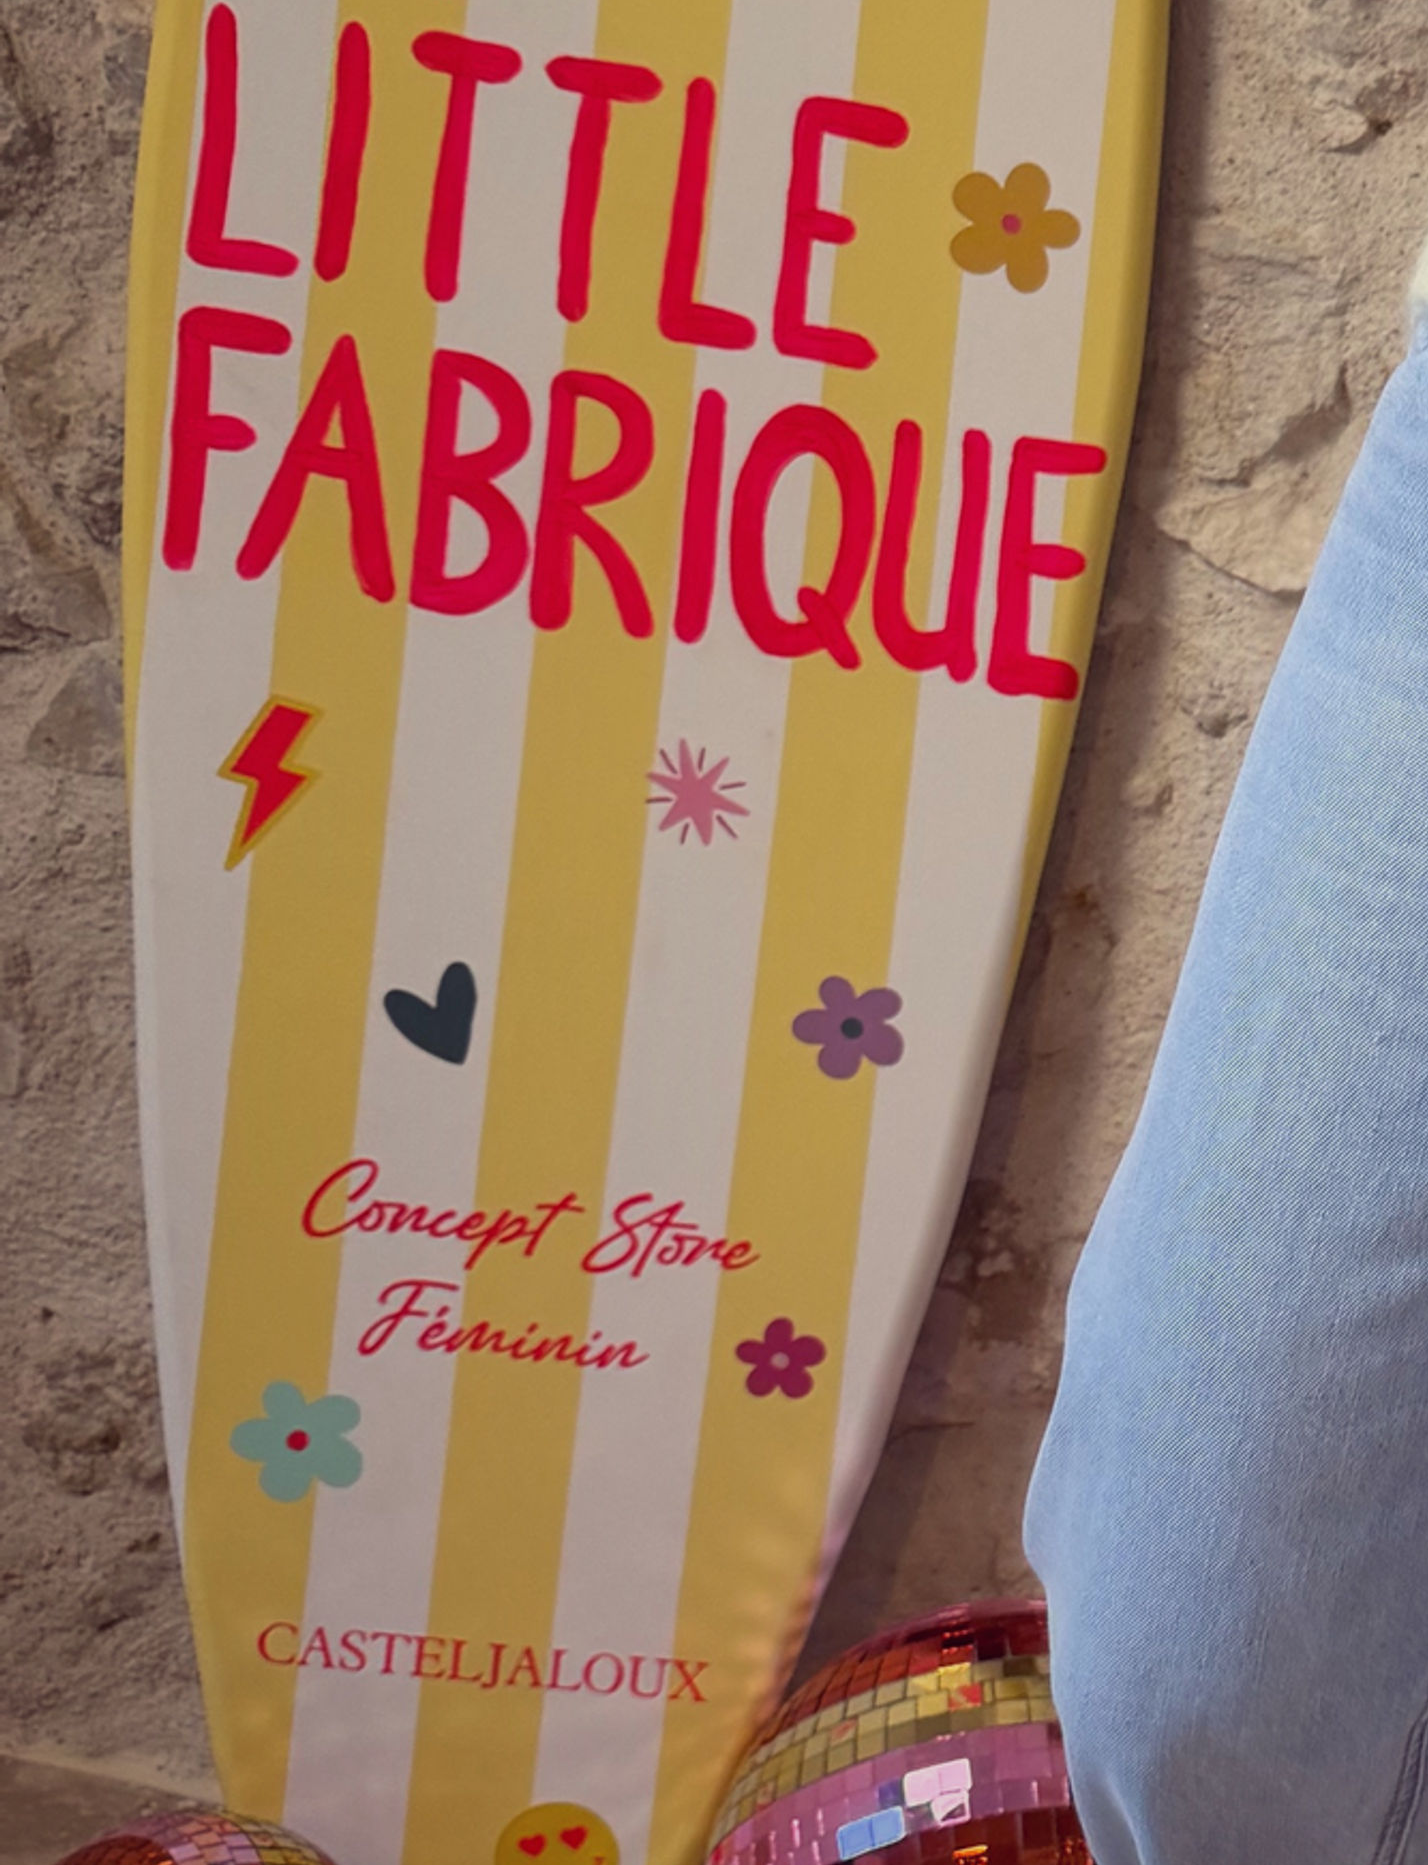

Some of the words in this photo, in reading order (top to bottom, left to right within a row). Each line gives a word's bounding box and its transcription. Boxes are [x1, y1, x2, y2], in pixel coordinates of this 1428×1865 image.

[184, 1, 911, 372] LITTLE
[161, 303, 1109, 703] FABRIQUE
[300, 1157, 586, 1272] Concept
[580, 1191, 761, 1280] Store
[356, 1277, 651, 1371] Féminin
[256, 1622, 709, 1705] CASTELJALOUX
